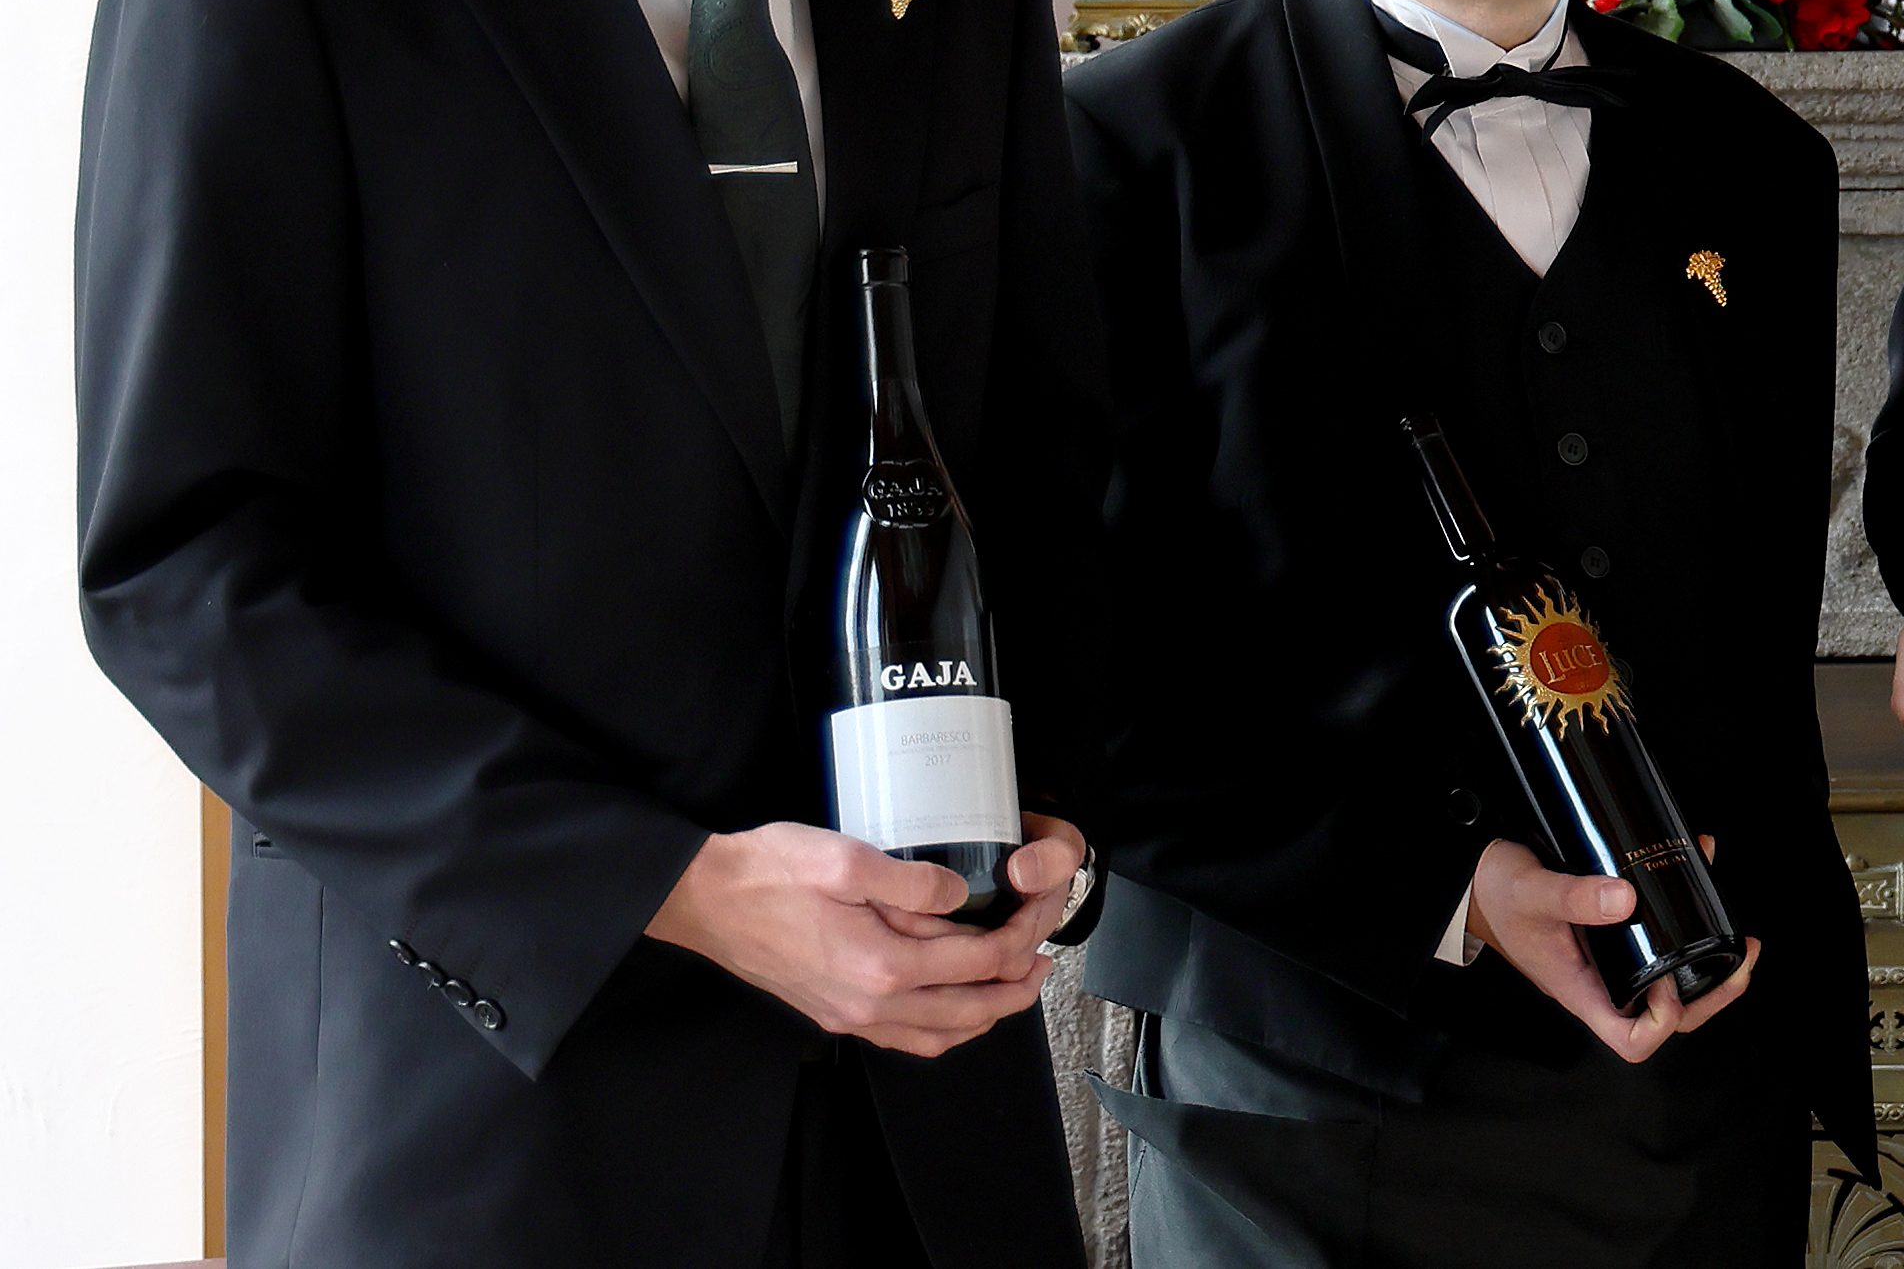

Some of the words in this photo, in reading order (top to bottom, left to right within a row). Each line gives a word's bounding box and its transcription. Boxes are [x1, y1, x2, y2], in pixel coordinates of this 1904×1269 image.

[880, 660, 978, 691] GAJA
[1539, 645, 1602, 685] LUCE
[901, 730, 971, 746] BARBARESCO
